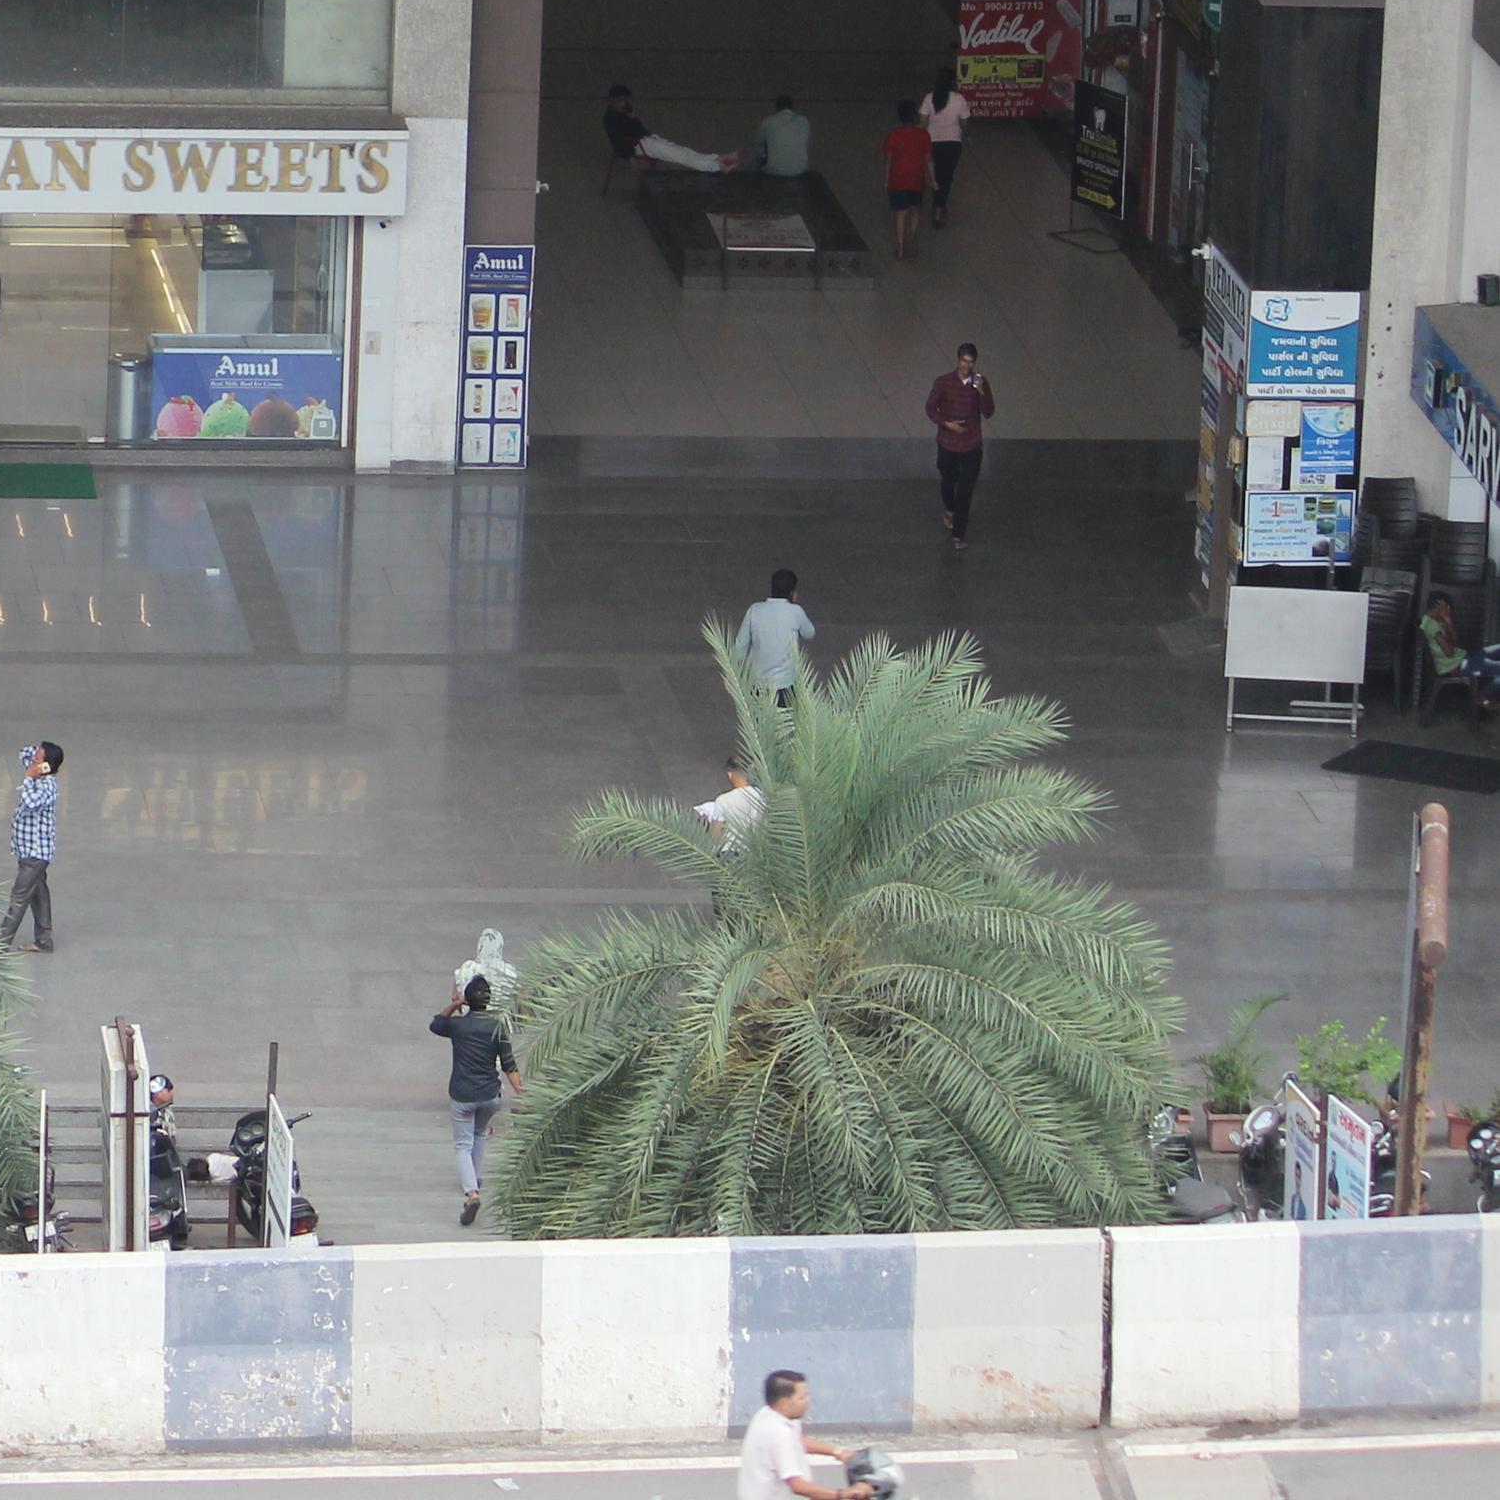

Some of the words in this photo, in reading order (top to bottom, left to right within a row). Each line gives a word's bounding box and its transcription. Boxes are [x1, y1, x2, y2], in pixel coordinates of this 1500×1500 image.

[959, 12, 1045, 55] Vadilal
[121, 136, 390, 195] SWEETS
[472, 252, 524, 272] Amul
[1212, 254, 1246, 328] VEDANTA
[1309, 335, 1338, 349] સુવિધા
[214, 354, 280, 378] Amul
[1310, 350, 1339, 364] સુવિધા
